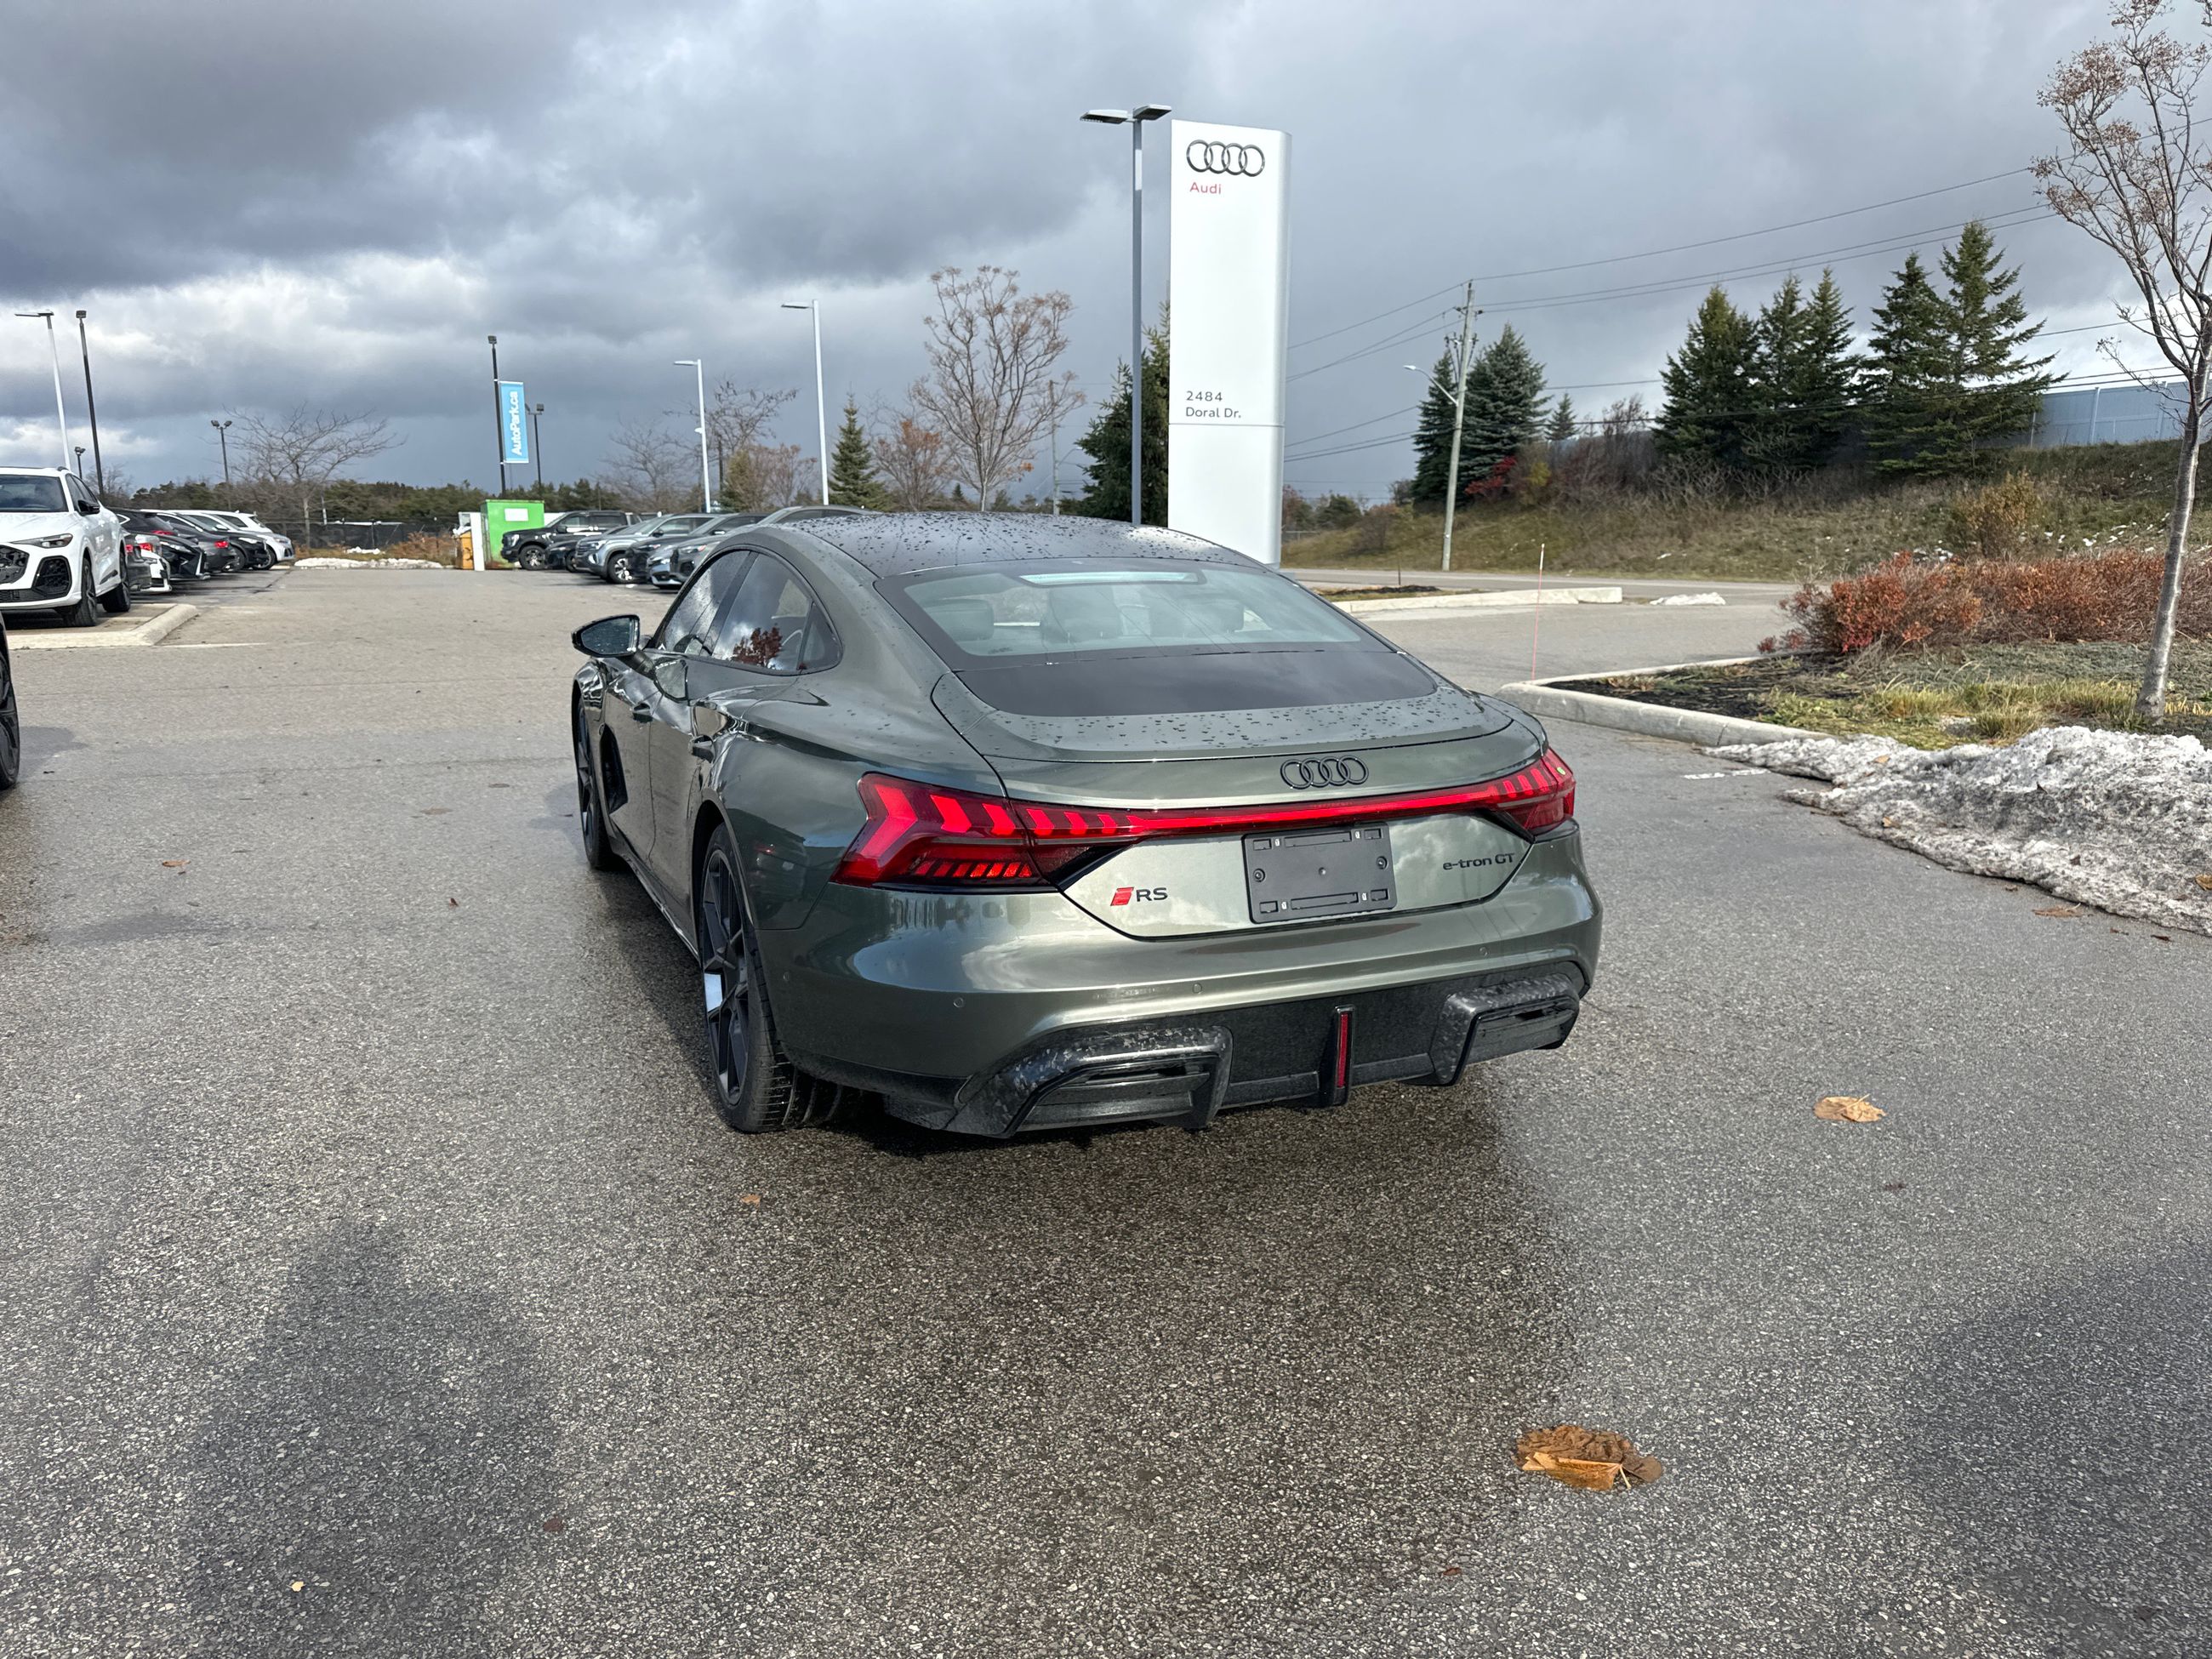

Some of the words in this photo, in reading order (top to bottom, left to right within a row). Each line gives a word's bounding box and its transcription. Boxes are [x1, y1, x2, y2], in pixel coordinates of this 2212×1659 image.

[1189, 181, 1222, 195] Audi
[1186, 391, 1223, 402] 2484
[1186, 407, 1220, 418] Doral
[1223, 408, 1242, 419] Dr.
[509, 391, 522, 456] AutoPark.ca
[1442, 858, 1492, 870] e-tron
[1495, 852, 1515, 864] GT
[1136, 887, 1168, 903] RS
